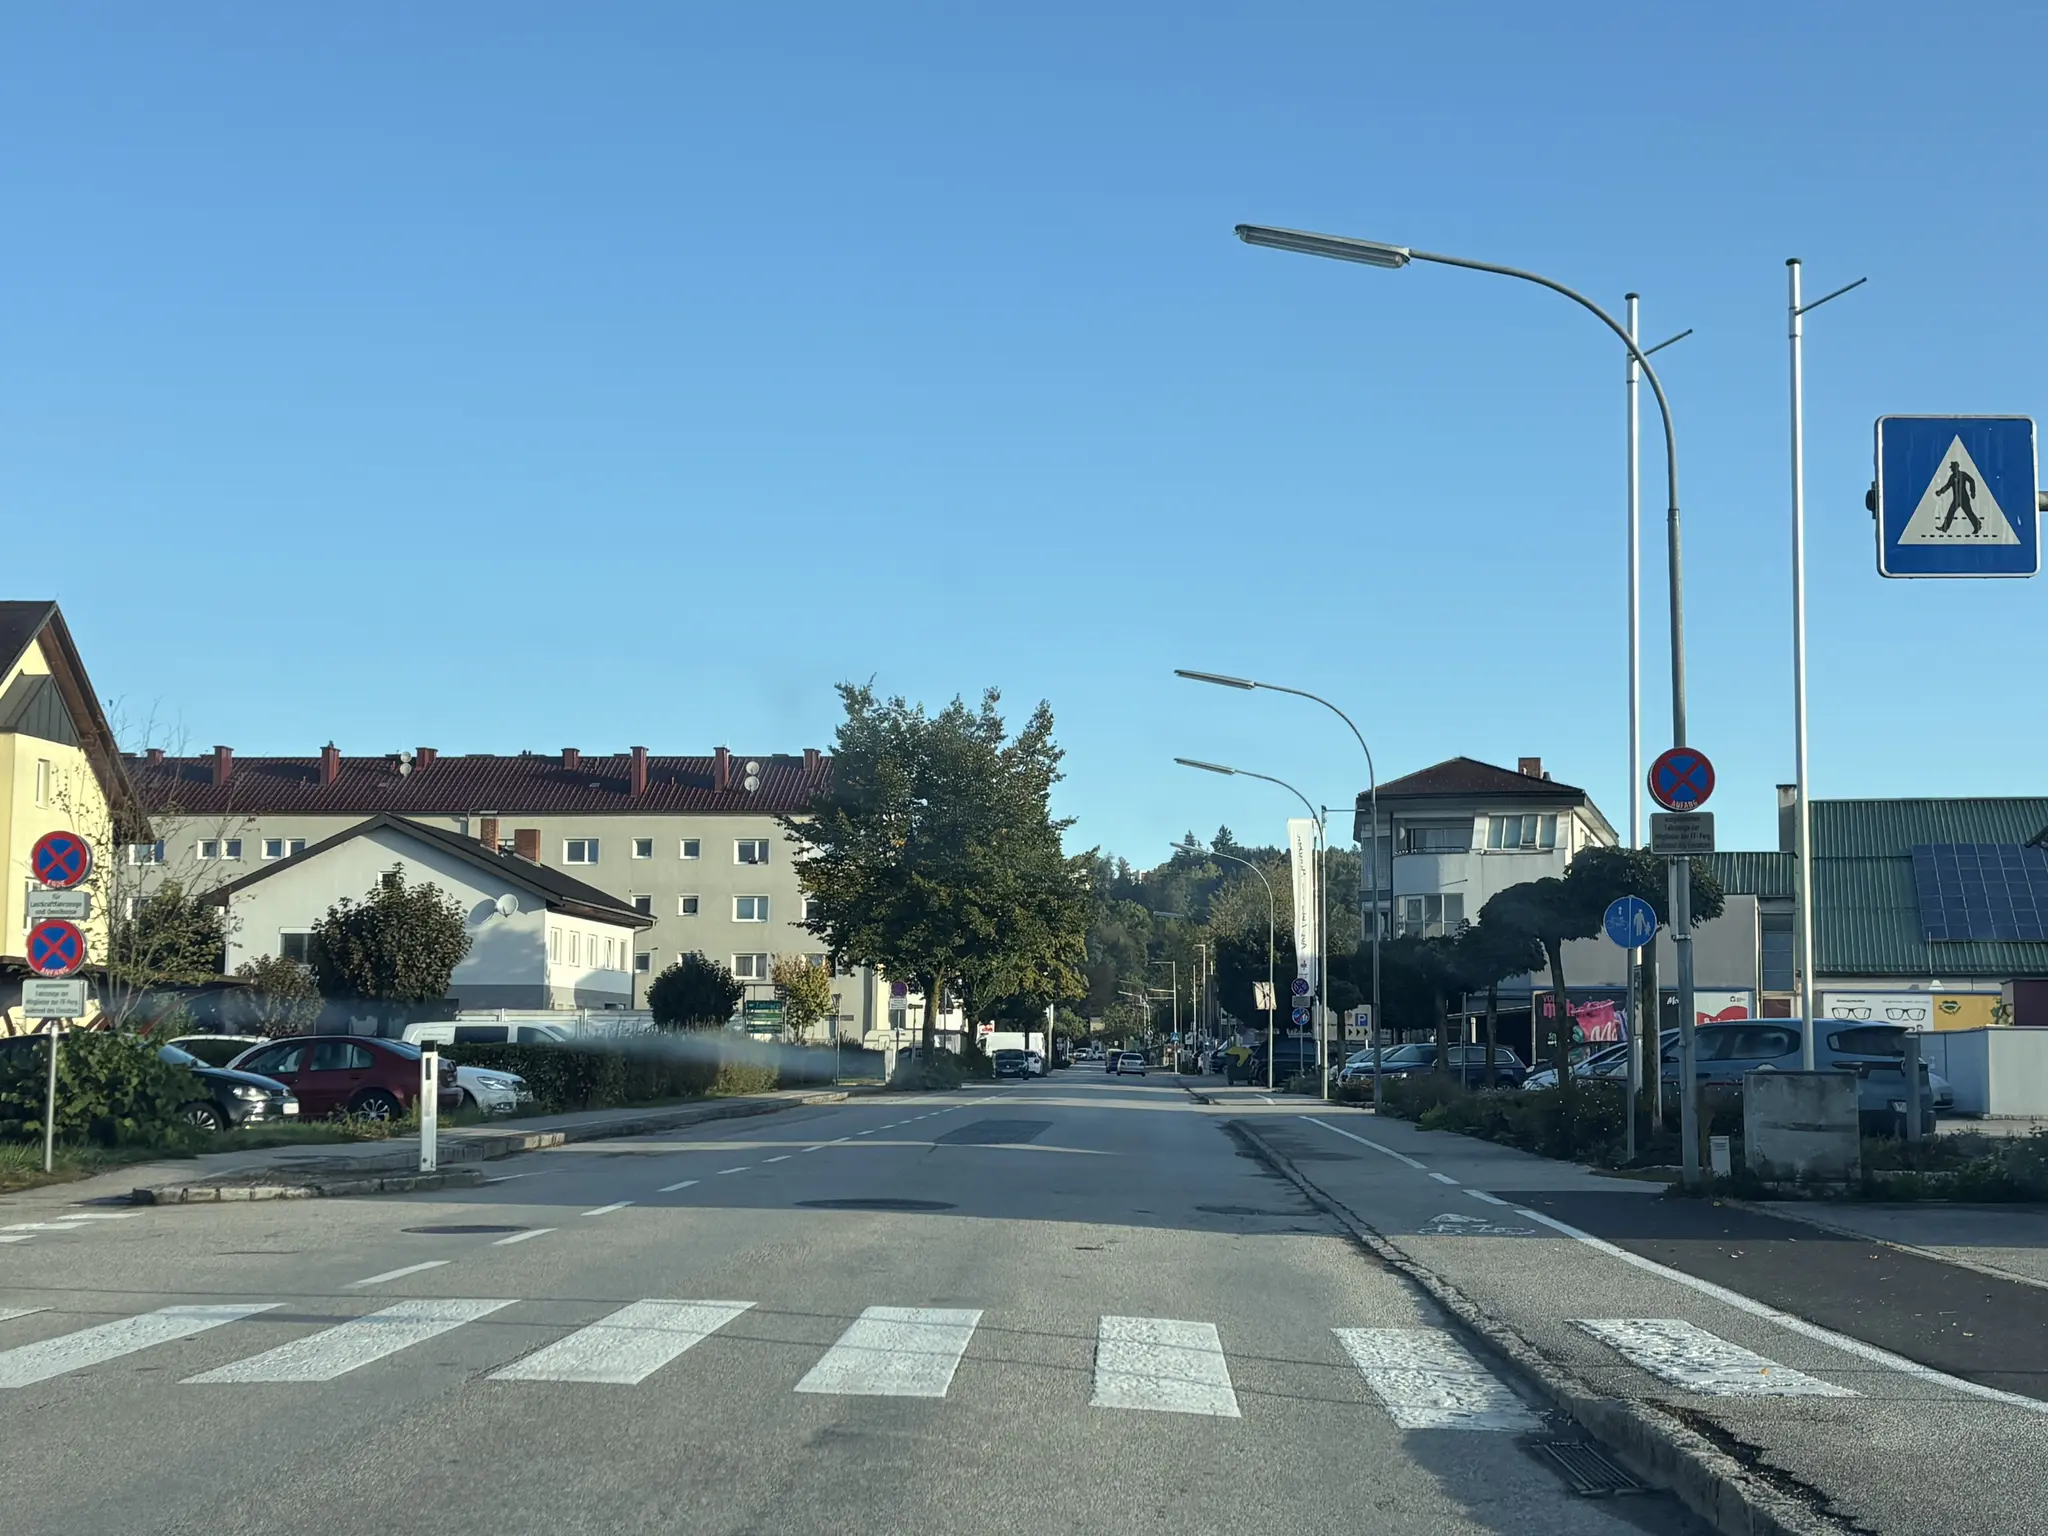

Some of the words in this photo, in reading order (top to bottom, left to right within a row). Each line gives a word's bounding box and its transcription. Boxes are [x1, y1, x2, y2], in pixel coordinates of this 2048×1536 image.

[1671, 800, 1698, 809] ANFANG
[40, 967, 70, 976] ANFANG
[1358, 1014, 1367, 1026] P
